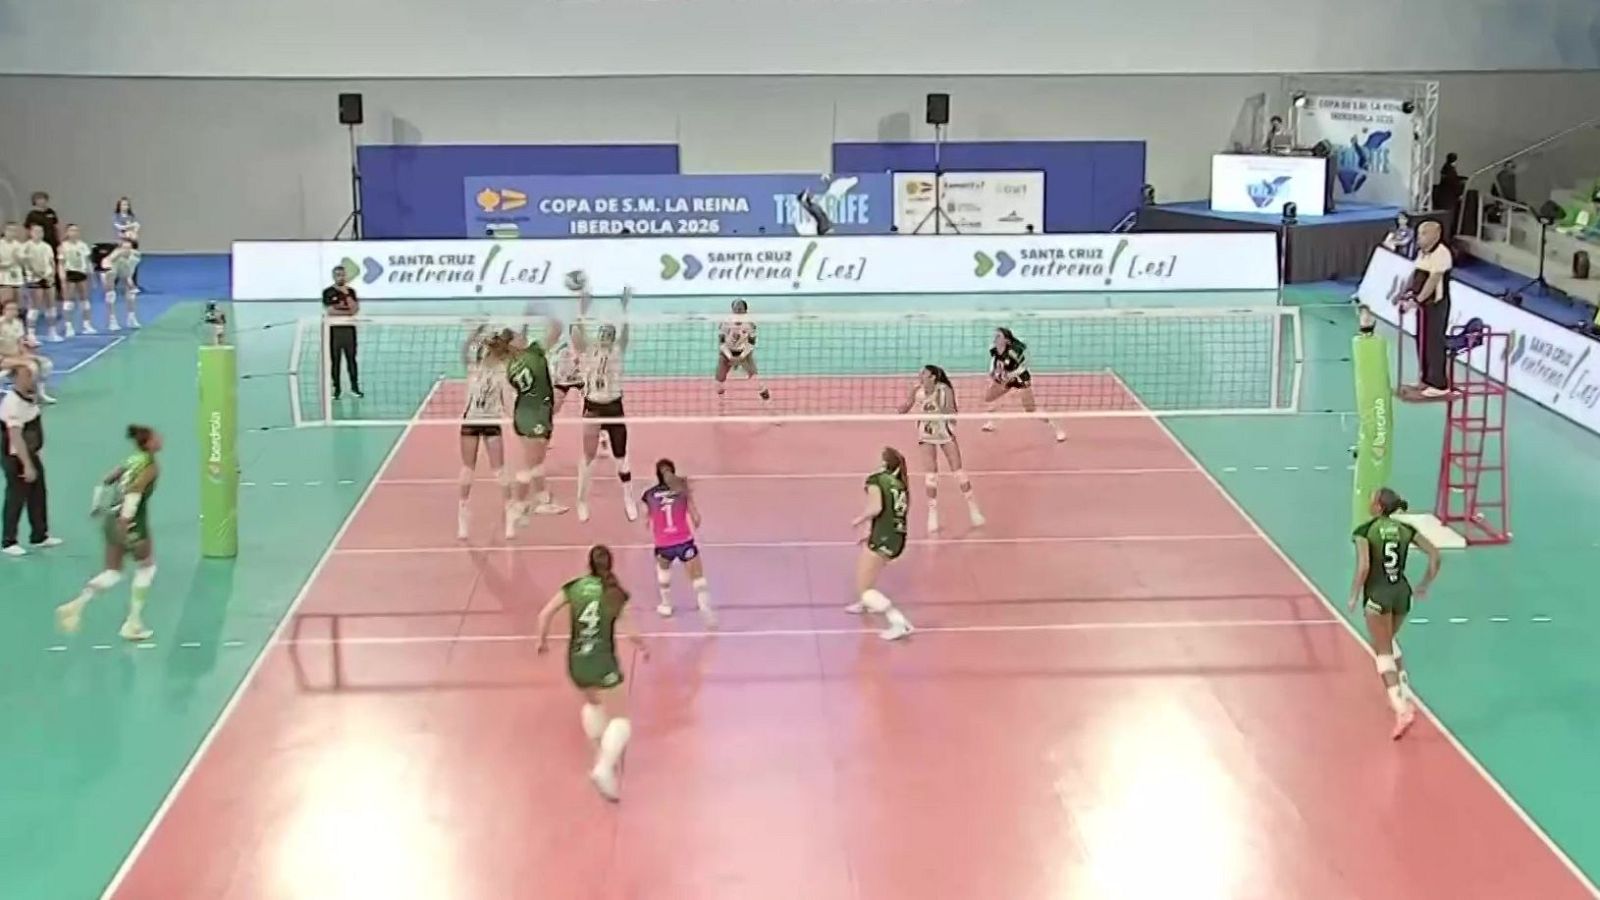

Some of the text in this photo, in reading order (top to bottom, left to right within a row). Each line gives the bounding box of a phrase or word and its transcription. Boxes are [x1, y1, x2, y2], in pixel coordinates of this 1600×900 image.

[539, 197, 750, 213] COPA DE S.M. LA REINA
[569, 219, 720, 234] IBERDROLA 2026
[388, 255, 476, 266] SANTA CRUZ
[707, 251, 792, 262] SANTA CRUZ
[1020, 249, 1104, 260] SANTA CRUZ
[660, 504, 677, 533] 1
[1384, 541, 1398, 568] 5
[579, 600, 600, 628] 4
